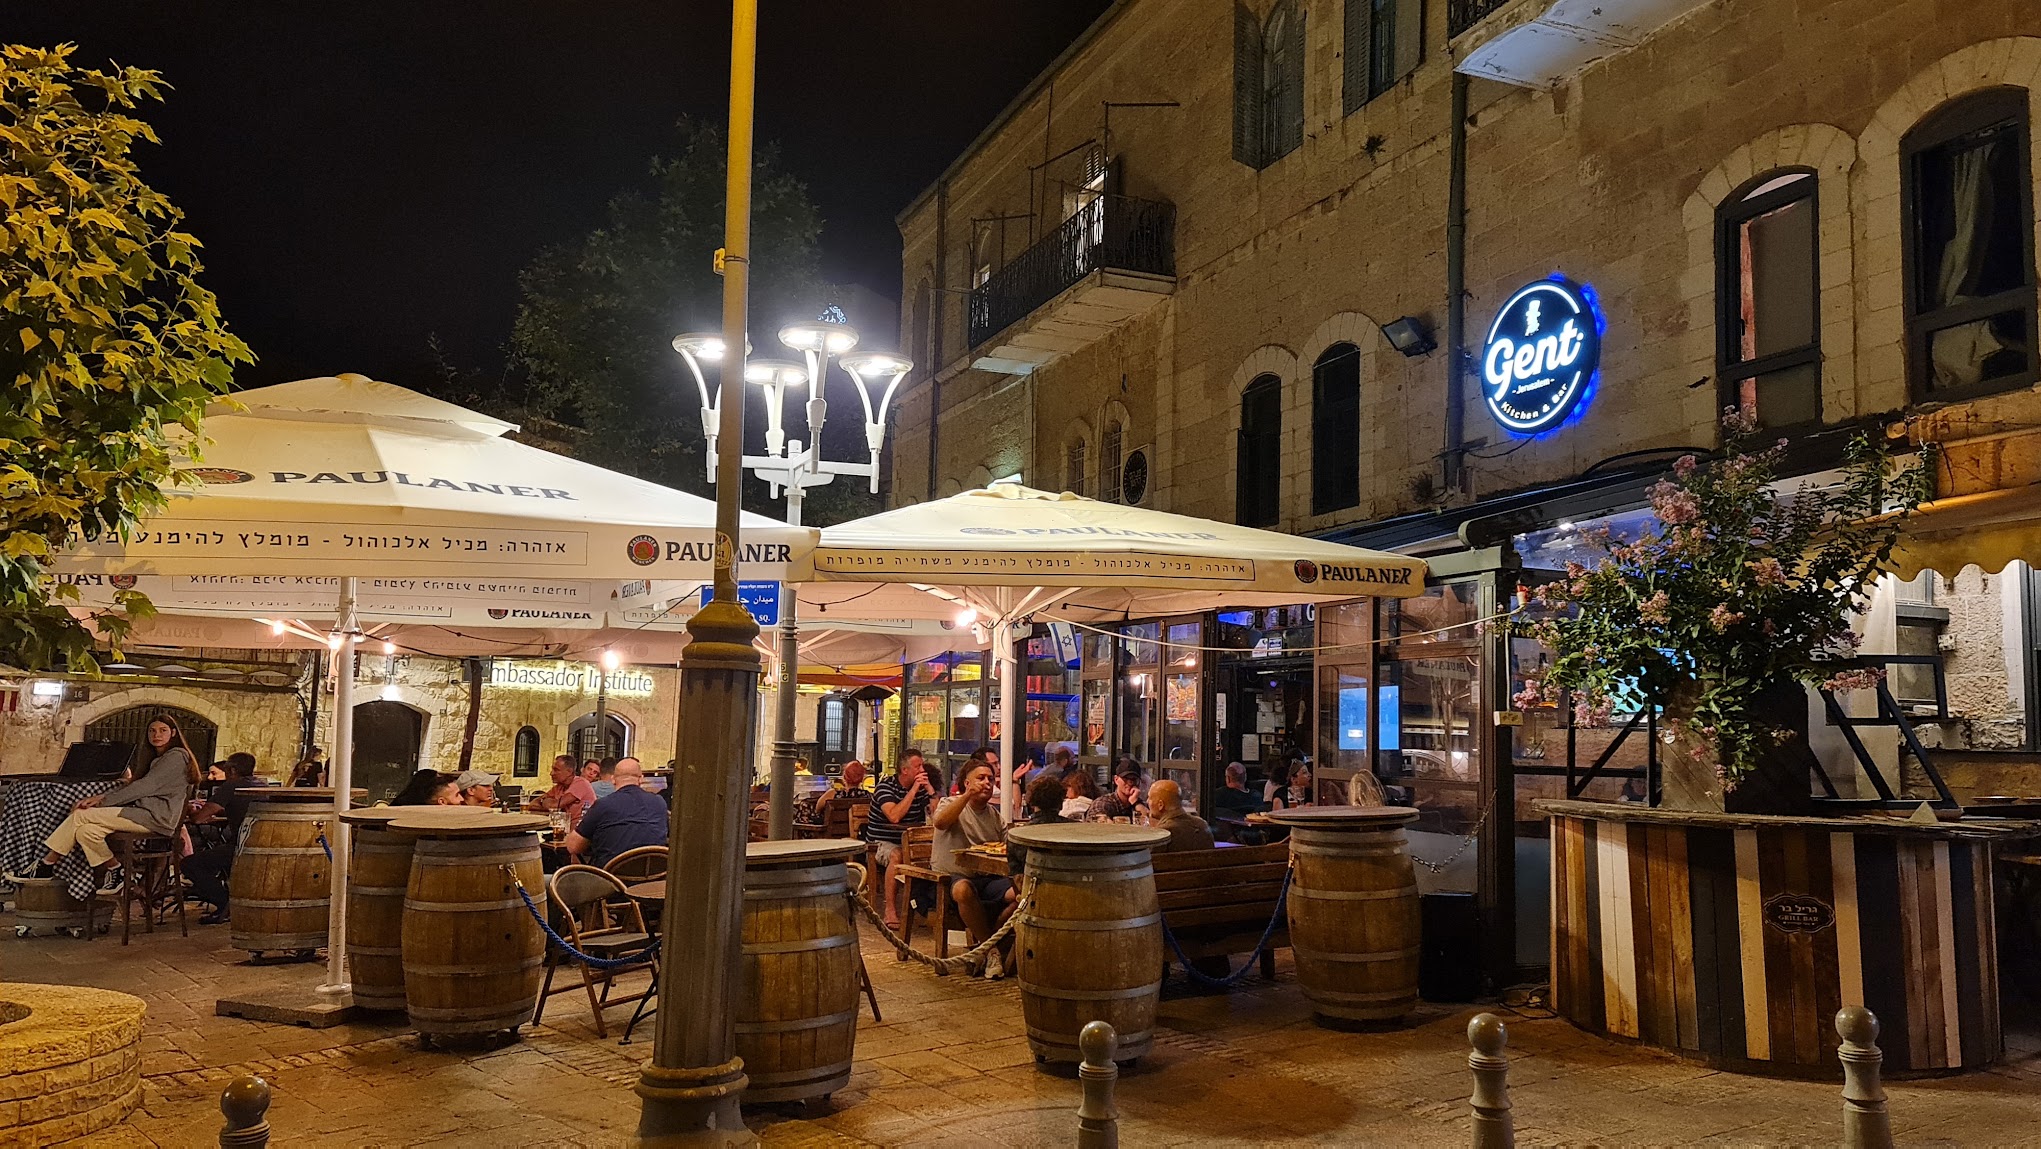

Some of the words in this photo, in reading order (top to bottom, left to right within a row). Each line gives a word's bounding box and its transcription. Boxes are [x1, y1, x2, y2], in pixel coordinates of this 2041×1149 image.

[1485, 318, 1582, 401] Gent
[1501, 401, 1539, 419] Kitchen
[268, 470, 579, 501] PAULANER
[135, 531, 224, 545] להימנע
[238, 532, 309, 548] מומלץ
[1018, 526, 1225, 541] PAULANER
[343, 534, 430, 549] אלכוהול
[442, 537, 488, 551] מכיל
[499, 541, 566, 553] אזהרה:
[826, 556, 884, 565] מופרזת
[895, 557, 952, 566] משתייה
[963, 557, 1016, 567] להימנע
[1028, 558, 1070, 569] מומלץ
[1094, 559, 1150, 569] אלכוהול
[1160, 561, 1191, 571] מכיל
[1200, 564, 1245, 573] אזהרה:
[1320, 564, 1412, 585] PAULANER
[491, 661, 583, 687] mbassador
[588, 669, 652, 692] Institute
[1778, 904, 1793, 912] בר
[1794, 904, 1818, 914] גריל
